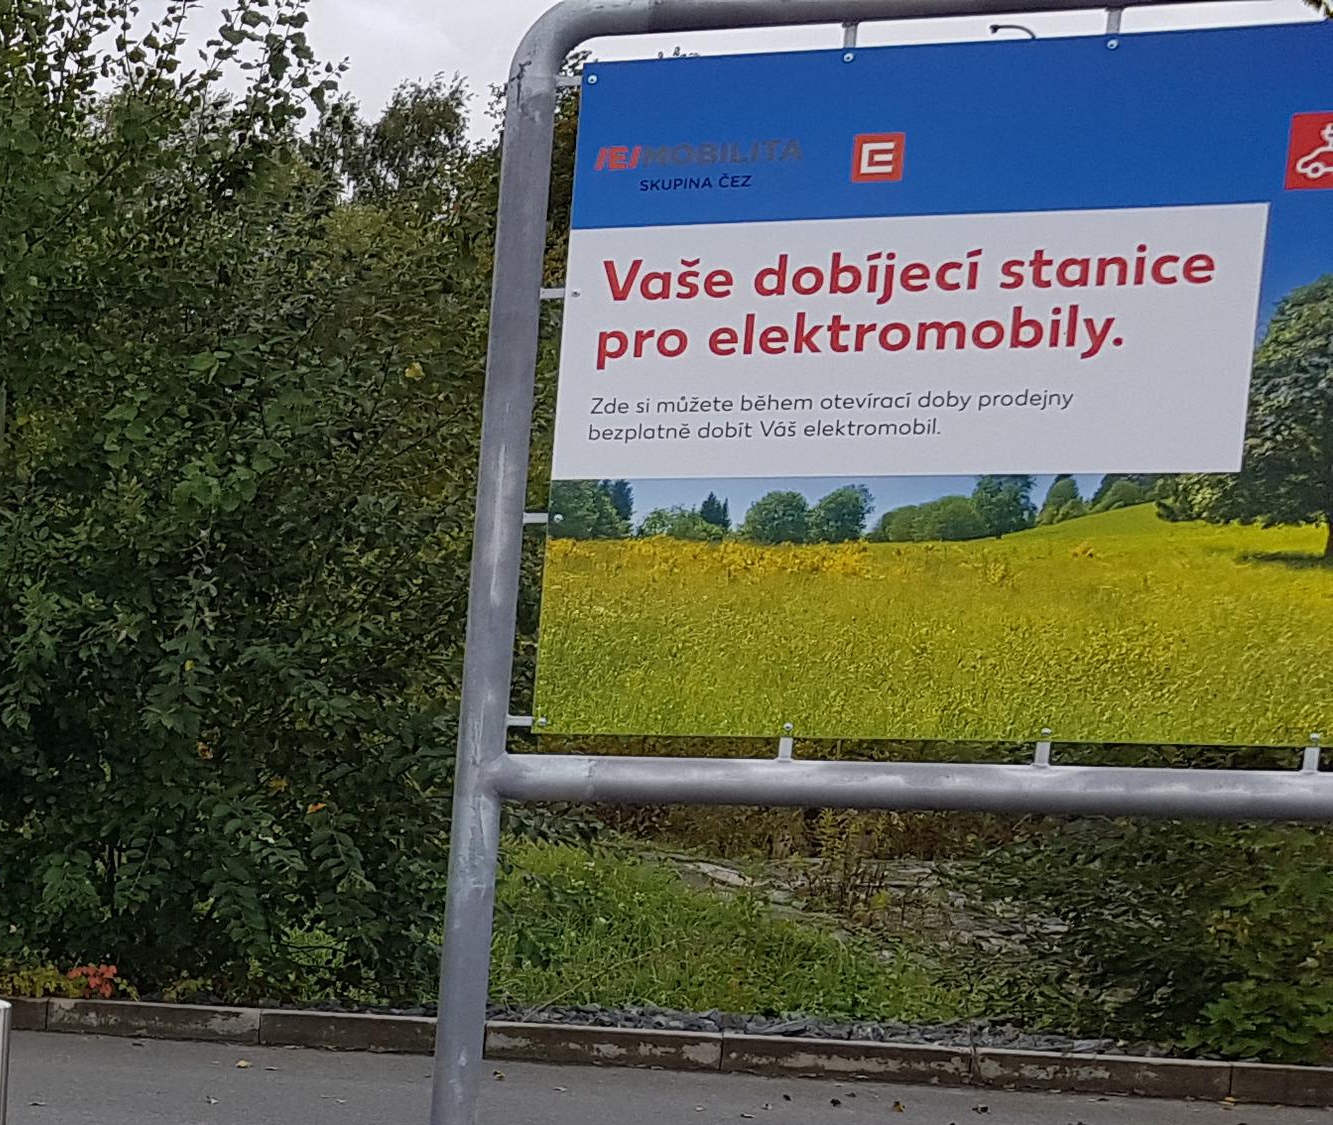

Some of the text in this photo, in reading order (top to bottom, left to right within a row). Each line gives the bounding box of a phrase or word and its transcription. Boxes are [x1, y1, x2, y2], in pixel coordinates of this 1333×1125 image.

[639, 173, 752, 192] SKUPINA ČEZ
[603, 244, 1216, 305] Vaše dobíjecí stanice
[596, 305, 1125, 370] pro elektromobily.
[590, 389, 1074, 415] Zde si můžete během otevírací doby prodejny
[588, 418, 942, 443] bezplatně dobít Váš elektromobil.
